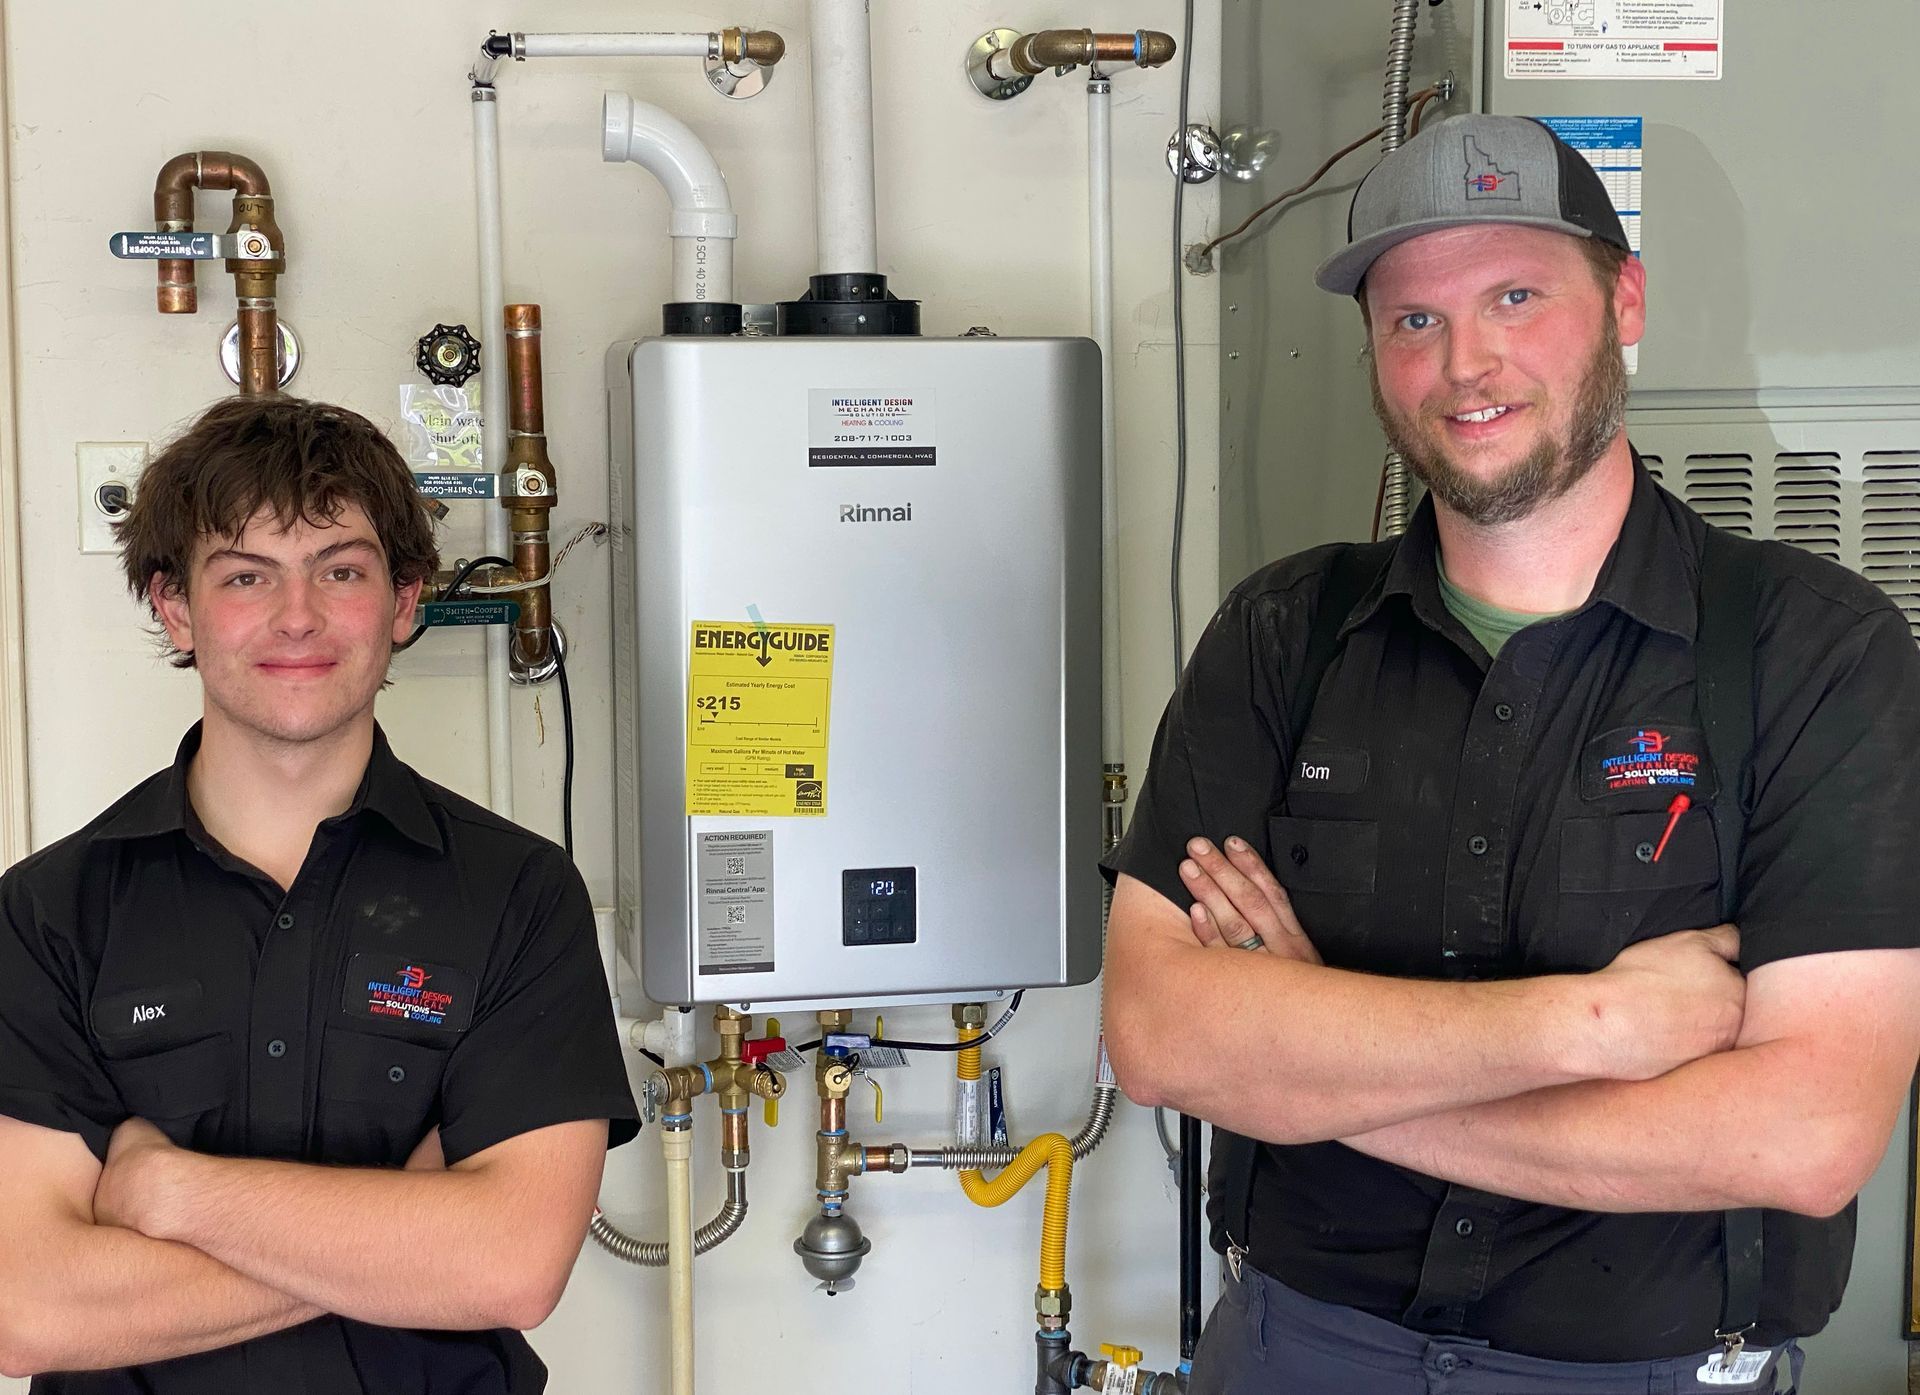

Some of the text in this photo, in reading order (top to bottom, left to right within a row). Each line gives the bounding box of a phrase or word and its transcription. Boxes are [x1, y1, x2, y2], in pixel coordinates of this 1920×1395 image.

[239, 203, 264, 214] OUT
[130, 245, 191, 256] SMITH-COOPER
[696, 245, 706, 264] SCH
[696, 268, 705, 279] 40
[696, 282, 705, 299] 280
[832, 398, 913, 406] INTELLIGENT DESIGN
[418, 415, 485, 427] Main wate
[840, 502, 912, 522] Rinnai
[446, 607, 503, 615] SMITH-COOPER
[696, 630, 829, 652] ENERGYGUIDE
[697, 695, 741, 710] $215
[1602, 752, 1699, 769] INTELLIGENT DESIGN
[1301, 762, 1330, 780] Tom
[1610, 762, 1693, 774] MECHANICAL
[1624, 769, 1678, 779] SOLUTIONS
[1610, 778, 1647, 789] HEATING
[1657, 777, 1695, 785] COOLING
[871, 881, 894, 895] 120
[368, 982, 453, 1005] INTELLIGENT DESIGN
[373, 991, 444, 1010] MECHANICAL
[133, 1004, 166, 1024] Alex
[370, 1005, 403, 1016] HEATING
[411, 1012, 442, 1024] COOLING
[386, 1001, 430, 1014] SOLUTIONS
